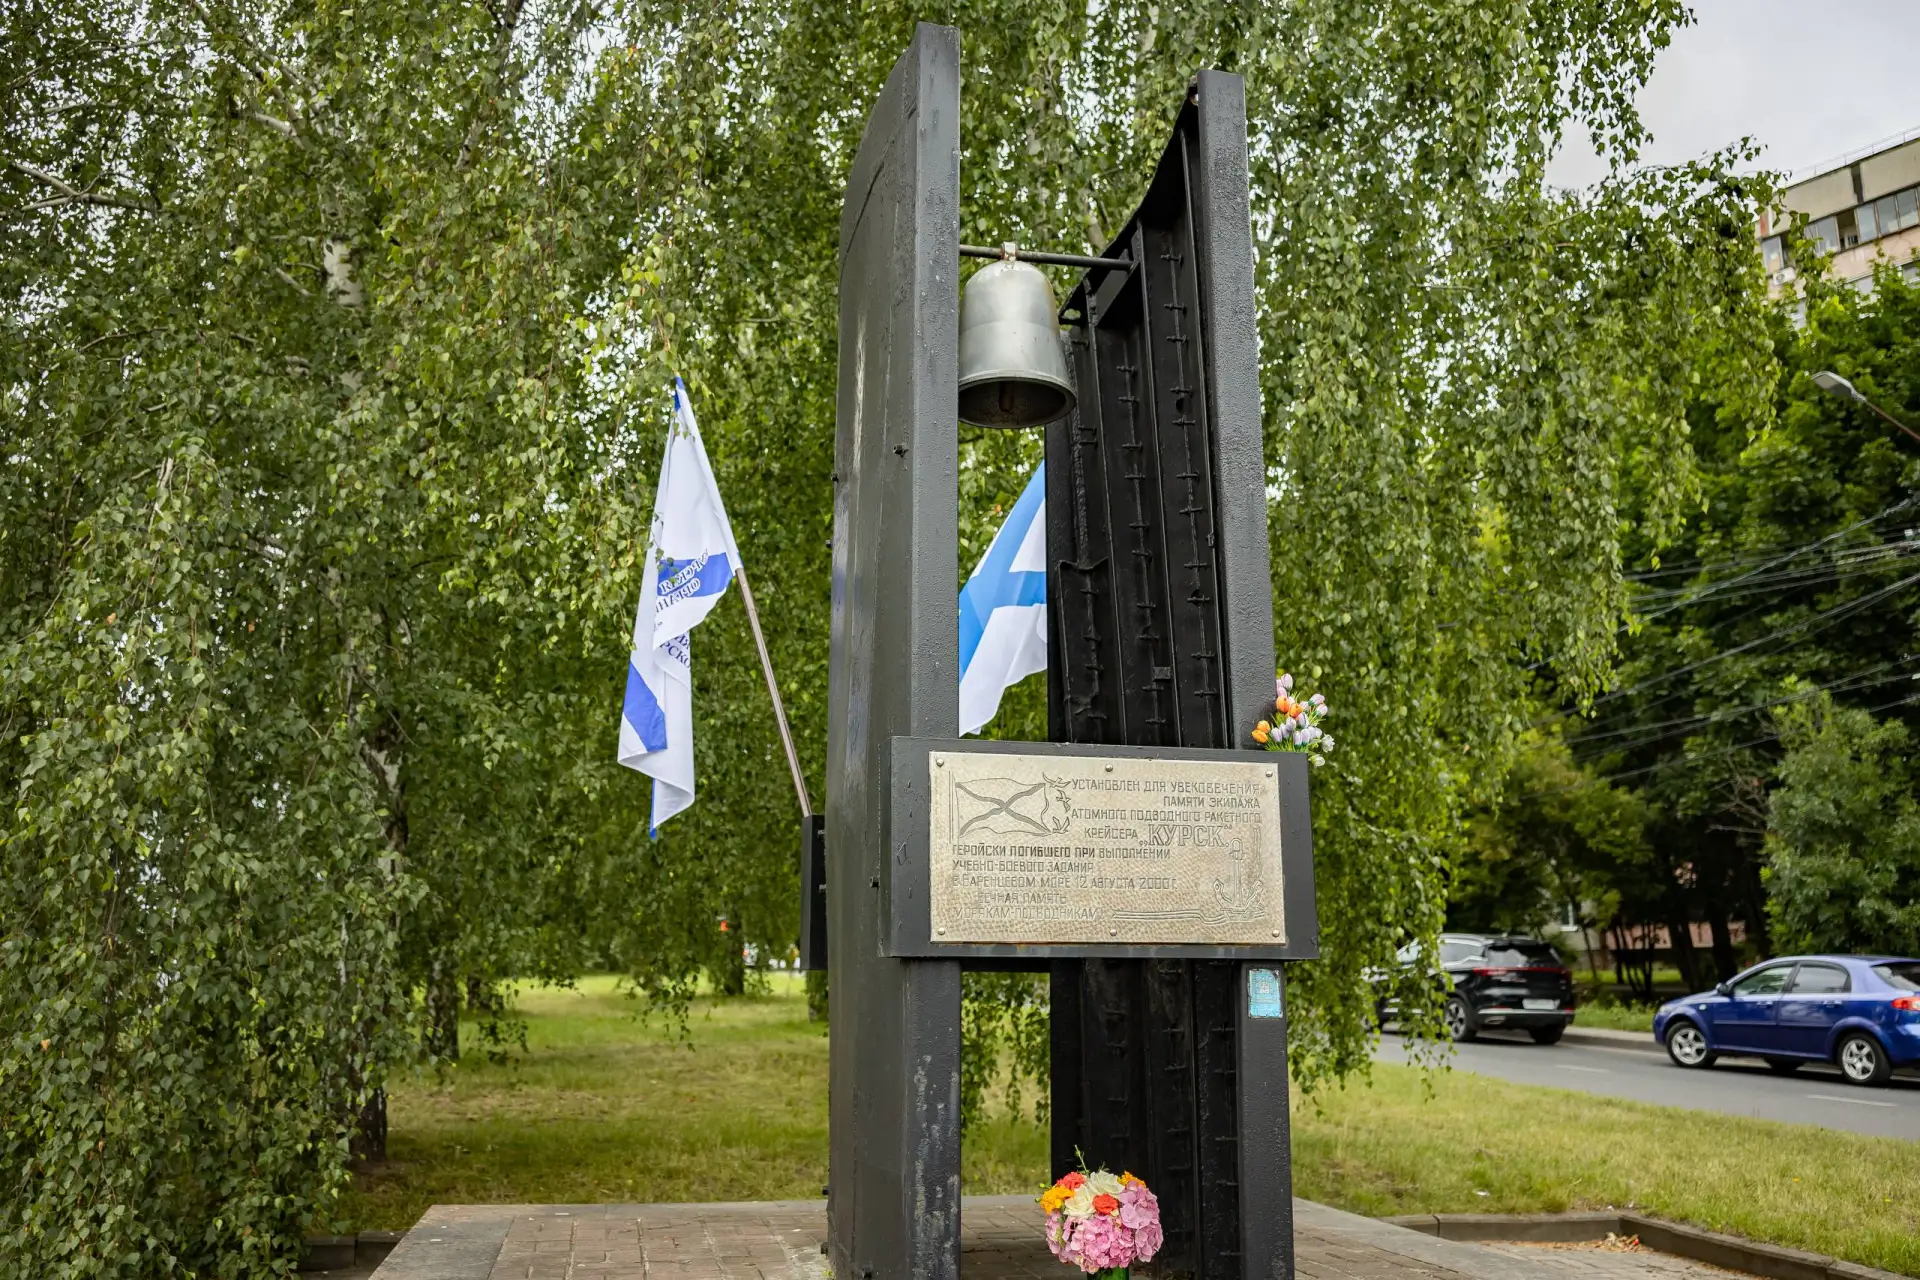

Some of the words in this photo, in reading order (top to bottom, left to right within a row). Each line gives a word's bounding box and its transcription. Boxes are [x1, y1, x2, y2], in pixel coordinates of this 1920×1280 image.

[1072, 779, 1140, 792] УСТАНОВЛЕН
[1144, 780, 1166, 793] ДЛЯ
[1171, 781, 1260, 795] УВЕКОВЕЧЕНИЯ
[1163, 796, 1205, 807] ПАМЯТИ
[1209, 797, 1261, 809] ЭКИПАЖА
[1071, 808, 1127, 820] АТОМНОГО
[1130, 809, 1201, 822] ПОДВОДНОГО
[1204, 811, 1262, 824] РАКЕТНОГО
[1084, 825, 1139, 839] КРЕЙСЕРА
[953, 842, 1006, 857] ГЕРОЙСКИ
[1010, 845, 1071, 858] ПОГИБШЕГО
[1075, 847, 1095, 858] ПРИ
[1099, 847, 1171, 860] ВЫПОЛНЕНИИ
[952, 860, 1044, 873] УЧЕБНО-БОЕВОГО
[1047, 861, 1094, 874] ЗАДАНИЯ
[962, 873, 1036, 888] БАРЕНЦЕВОМ
[1040, 876, 1071, 889] МОРЕ
[1075, 877, 1088, 889] 12
[1091, 877, 1136, 890] АВГУСТА
[977, 892, 1019, 904] ВЕЧНАЯ
[1022, 892, 1067, 904] ПАМЯТЬ
